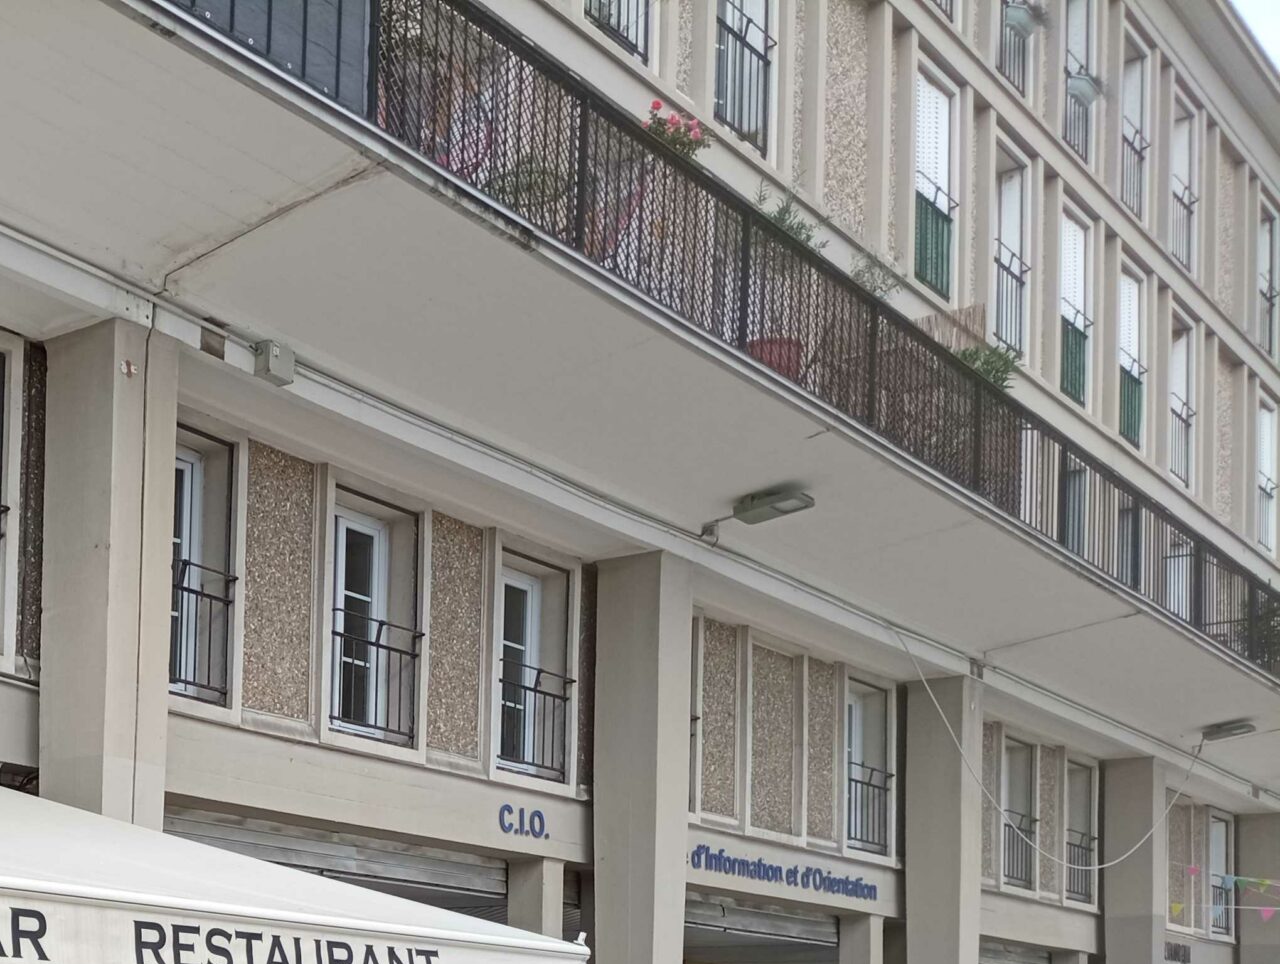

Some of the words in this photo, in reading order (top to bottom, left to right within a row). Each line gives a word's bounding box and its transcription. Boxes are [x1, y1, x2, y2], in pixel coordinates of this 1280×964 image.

[498, 803, 550, 840] C.I.O.
[691, 844, 784, 883] d'Information
[785, 865, 799, 887] et
[801, 866, 878, 901] d'Orientation
